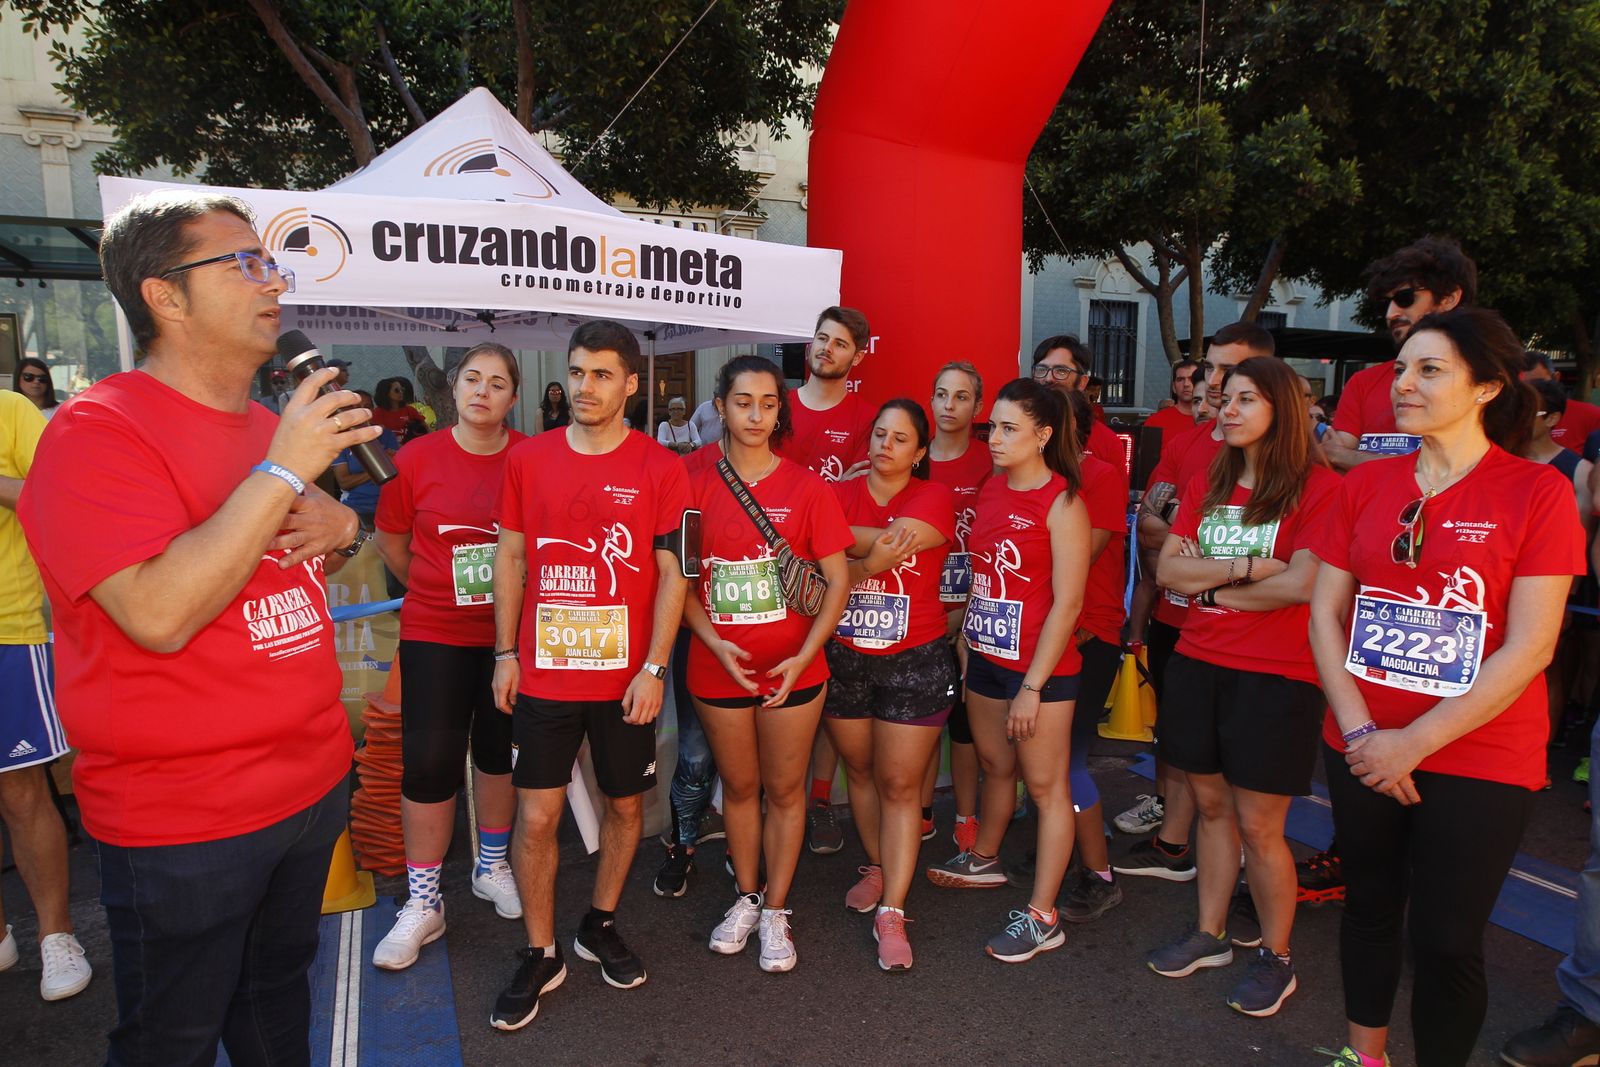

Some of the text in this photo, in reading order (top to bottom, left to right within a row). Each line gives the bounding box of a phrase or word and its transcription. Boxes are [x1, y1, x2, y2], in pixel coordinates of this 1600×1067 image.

[372, 220, 743, 290] cruzandolameta
[501, 273, 742, 309] cronometraje deportivo
[1370, 436, 1378, 449] 6
[1455, 520, 1498, 529] Santander
[1203, 525, 1259, 546] 1024
[471, 548, 479, 561] 6
[1210, 546, 1249, 556] SCIENCE YES!
[463, 564, 493, 584] 10
[540, 564, 596, 580] CARRERA
[718, 564, 725, 578] 6
[941, 568, 966, 585] 17
[540, 578, 596, 592] SOLIDARIA
[714, 579, 771, 602] 1018
[242, 585, 312, 623] CARRERA
[739, 602, 752, 611] IRIS
[849, 594, 855, 606] 6
[555, 609, 564, 622] 6
[837, 609, 894, 629] 2009
[1359, 609, 1375, 620] 2019
[1379, 603, 1390, 621] 6
[1395, 606, 1442, 620] CARRERA
[247, 604, 321, 642] SOLIDARIA
[966, 611, 1008, 638] 2016
[1395, 614, 1442, 627] SOLIDARIA
[545, 626, 612, 648] 3017
[853, 628, 875, 637] JULIETA
[1362, 623, 1457, 664] 2223
[565, 648, 580, 657] JUAN
[1381, 655, 1440, 677] MAGDALENA
[9, 747, 37, 758] adidas
